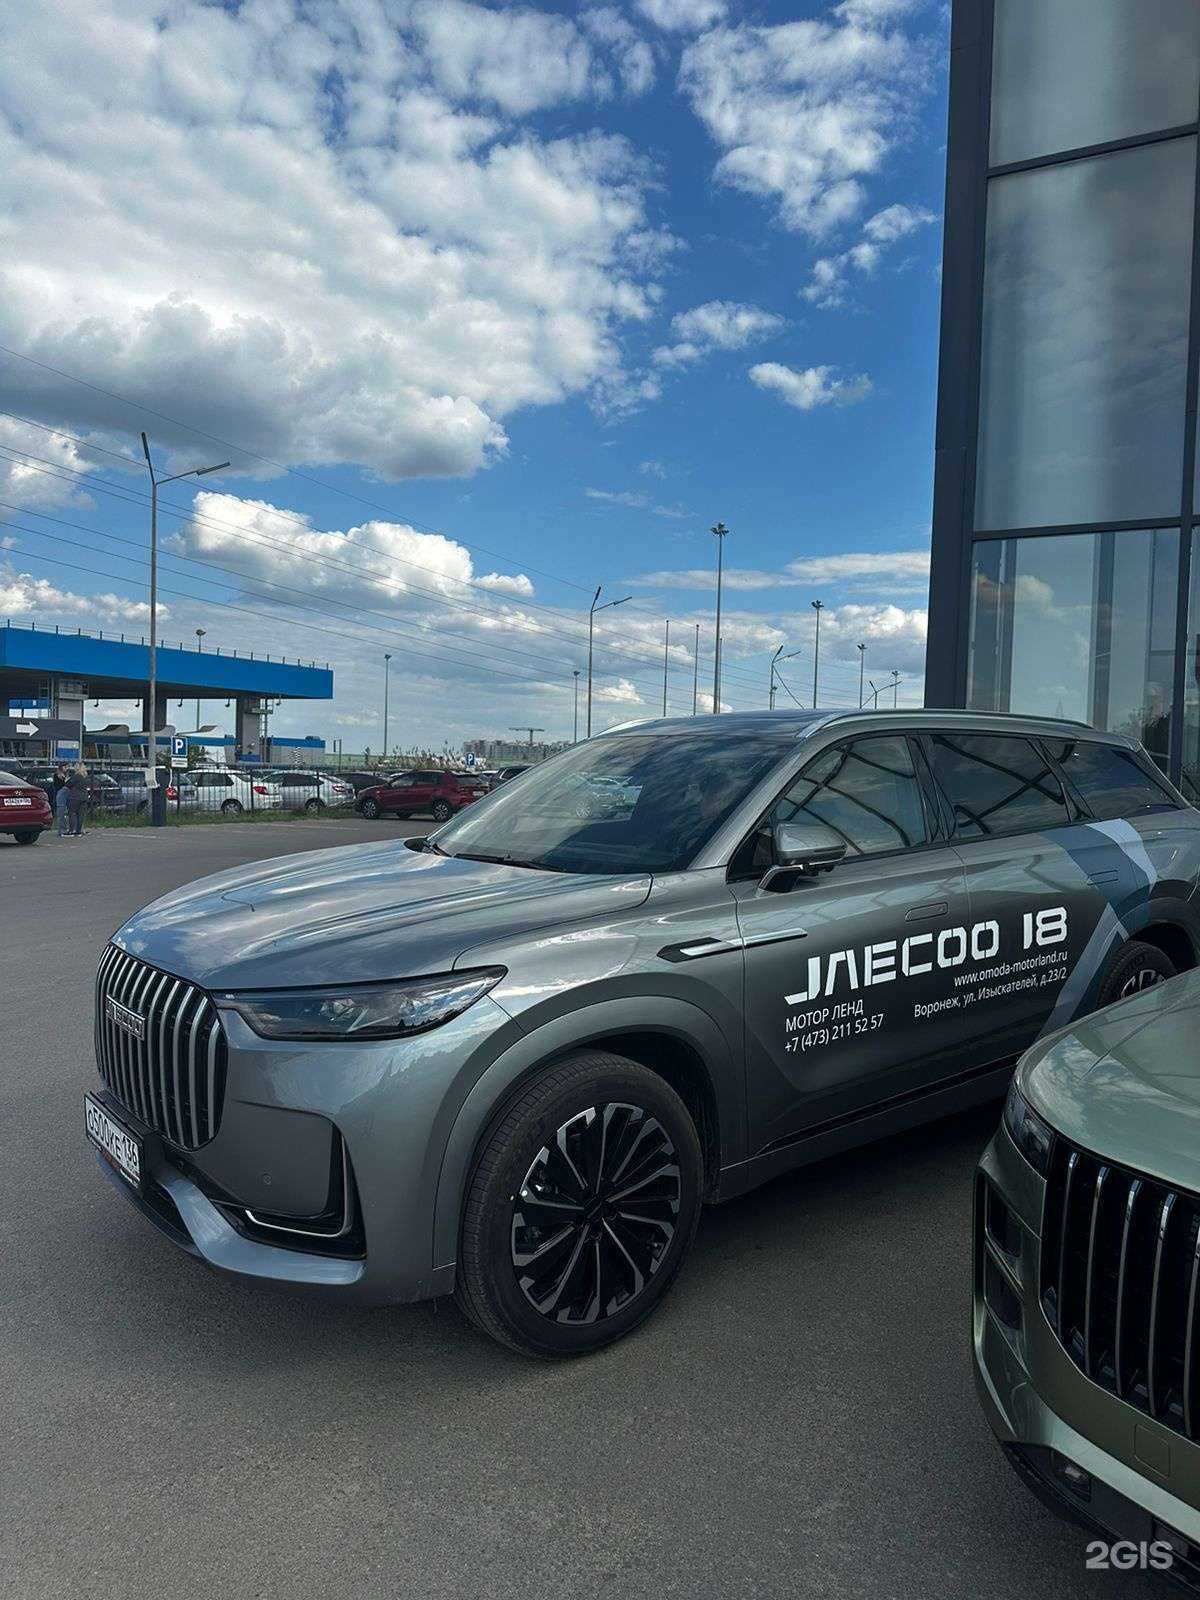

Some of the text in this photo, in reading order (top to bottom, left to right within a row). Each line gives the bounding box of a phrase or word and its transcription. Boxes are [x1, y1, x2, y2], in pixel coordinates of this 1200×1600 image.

[175, 739, 183, 753] P
[784, 920, 1000, 1005] JAECOO
[953, 950, 1068, 987] www.omoda-motorland.ru
[913, 996, 961, 1018] Воронеж,
[978, 974, 1038, 1001] Изыскателей,
[784, 1013, 884, 1052] +7 (473) 211 52 57
[785, 999, 864, 1033] МОТОР ЛЕНД
